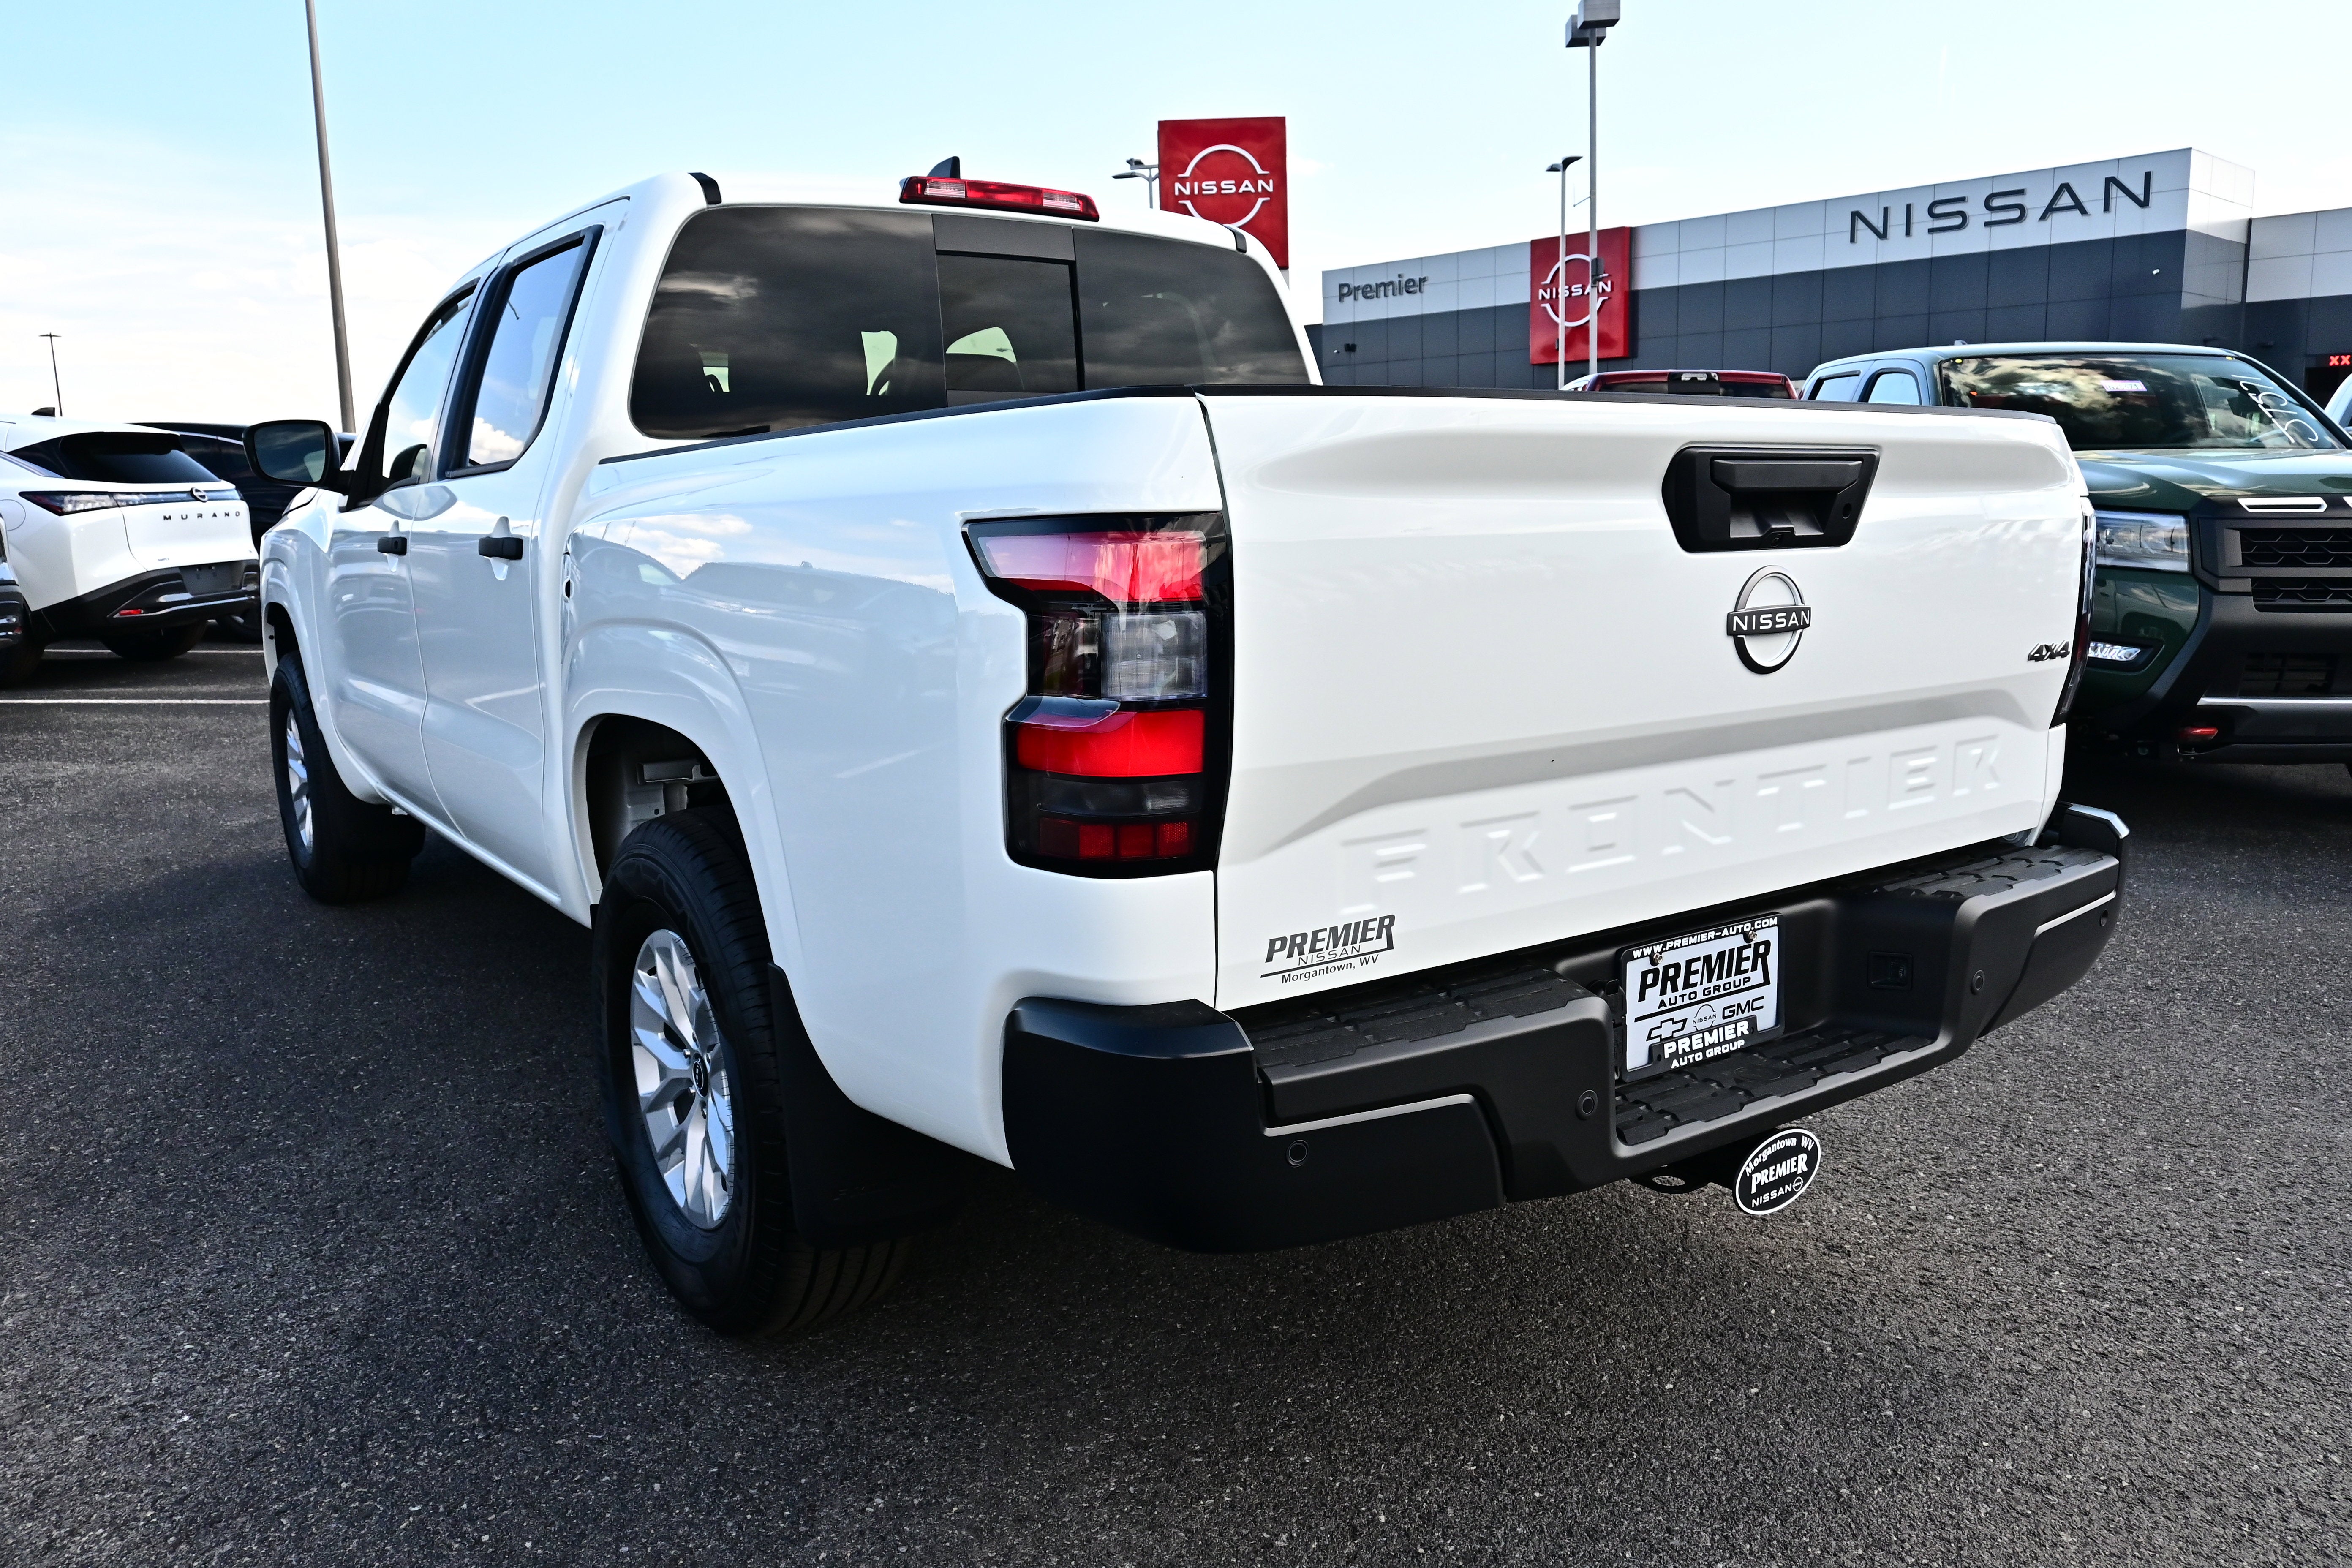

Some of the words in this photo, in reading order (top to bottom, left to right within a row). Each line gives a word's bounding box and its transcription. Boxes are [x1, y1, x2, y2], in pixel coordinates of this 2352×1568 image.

[1174, 179, 1274, 196] NISSAN
[1850, 171, 2153, 244] NISSAN
[1338, 273, 1428, 303] Premier
[163, 511, 240, 521] MURANO
[1733, 610, 1810, 631] NISSAN
[1337, 734, 2001, 916] FRONTIER
[1265, 914, 1395, 964] PREMIER
[1633, 917, 1778, 959] WWW.PREMIER-AUTO.COM
[1282, 961, 1356, 984] Morgantown,
[1360, 954, 1379, 966] WV
[1298, 945, 1361, 966] NISSAN
[1638, 939, 1771, 1003] PREMIER
[1658, 991, 1698, 1010] AUTO
[1703, 976, 1751, 997] GROUP
[1722, 996, 1764, 1020] GMC
[1692, 1013, 1717, 1025] NISSAN
[1663, 1020, 1749, 1059] PREMIER
[1671, 1054, 1703, 1069] AUTO
[1706, 1039, 1745, 1059] GROUP
[1745, 1137, 1797, 1177] Morgantown
[1801, 1135, 1815, 1151] WV
[1751, 1153, 1808, 1194] PREMIER
[1752, 1183, 1792, 1208] NISSAN
